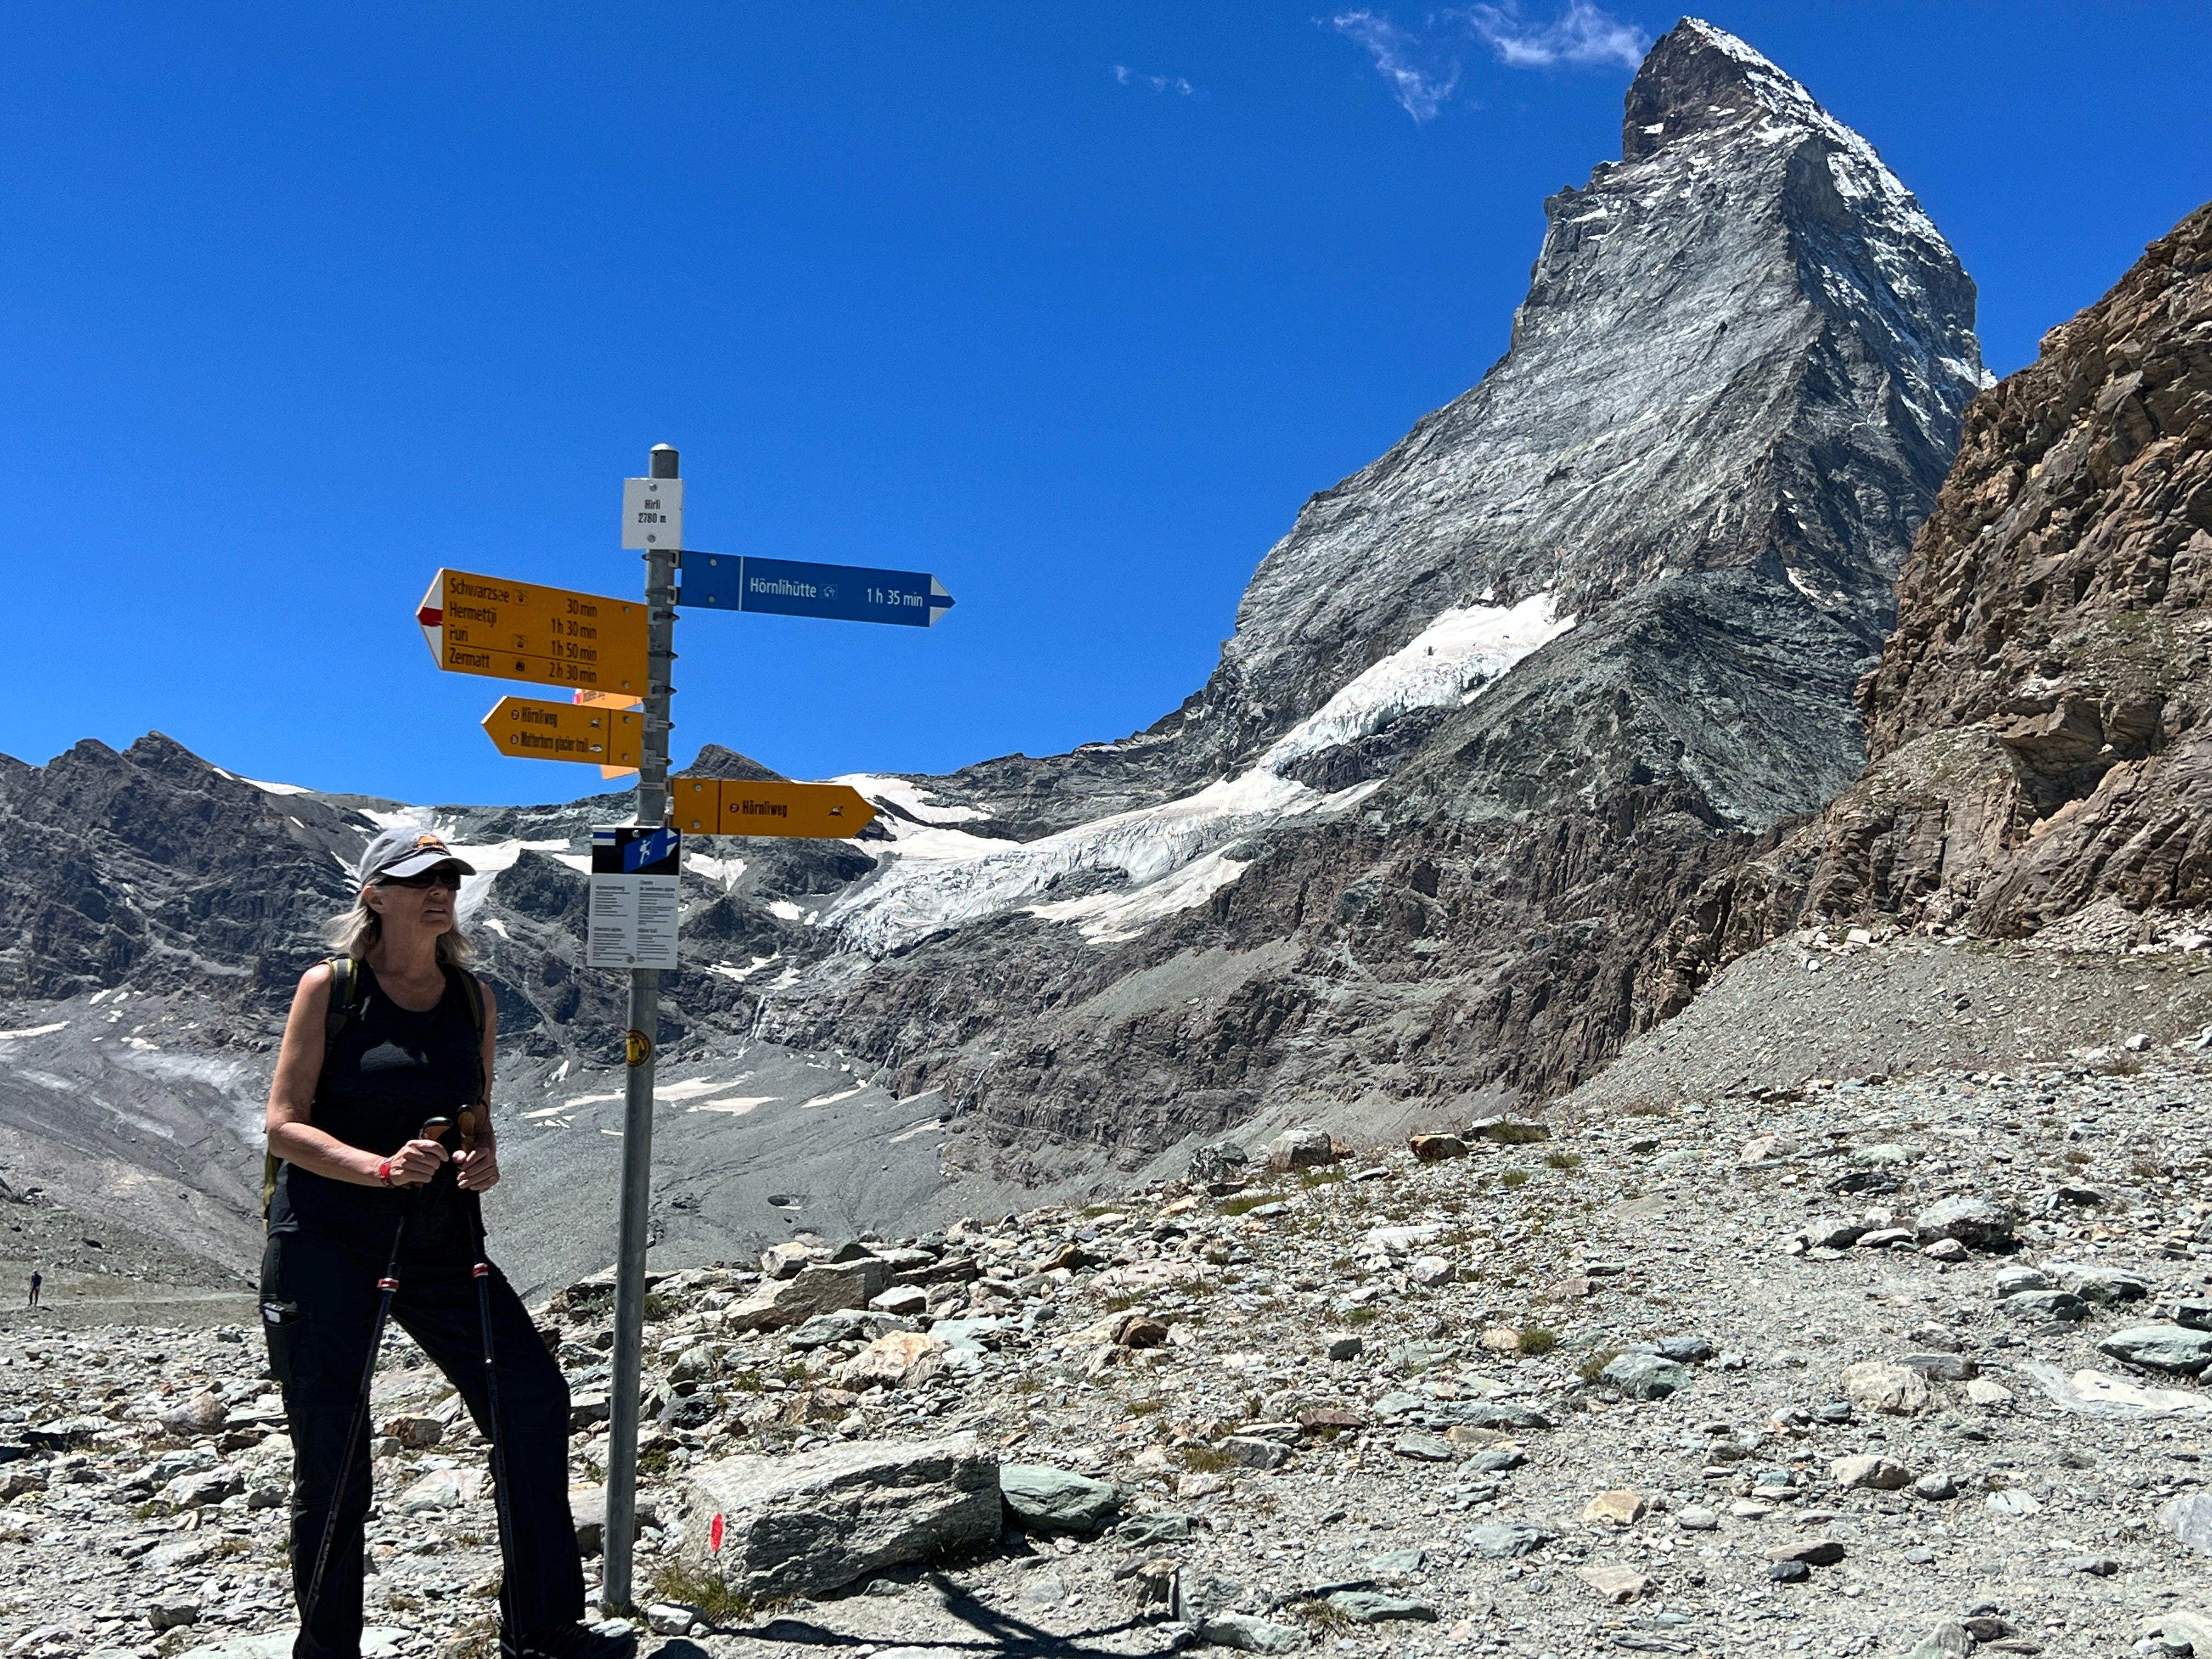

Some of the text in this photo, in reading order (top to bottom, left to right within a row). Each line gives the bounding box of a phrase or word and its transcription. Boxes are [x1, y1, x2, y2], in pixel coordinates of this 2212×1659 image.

[645, 499, 661, 510] Hirli
[638, 512, 667, 524] 2780 m
[450, 577, 598, 619] Schwarzsee 30 min
[749, 577, 923, 607] Hörnlihütte 1 h 35 min
[449, 601, 498, 628] Hermettji
[551, 617, 556, 634] 1
[566, 620, 579, 637] 30
[580, 623, 597, 640] min
[551, 640, 556, 656] 1
[566, 642, 579, 659] 50
[580, 645, 597, 662] min
[449, 647, 597, 684] Zermatt 2 h 30 min
[742, 800, 788, 818] Hörnliweg
